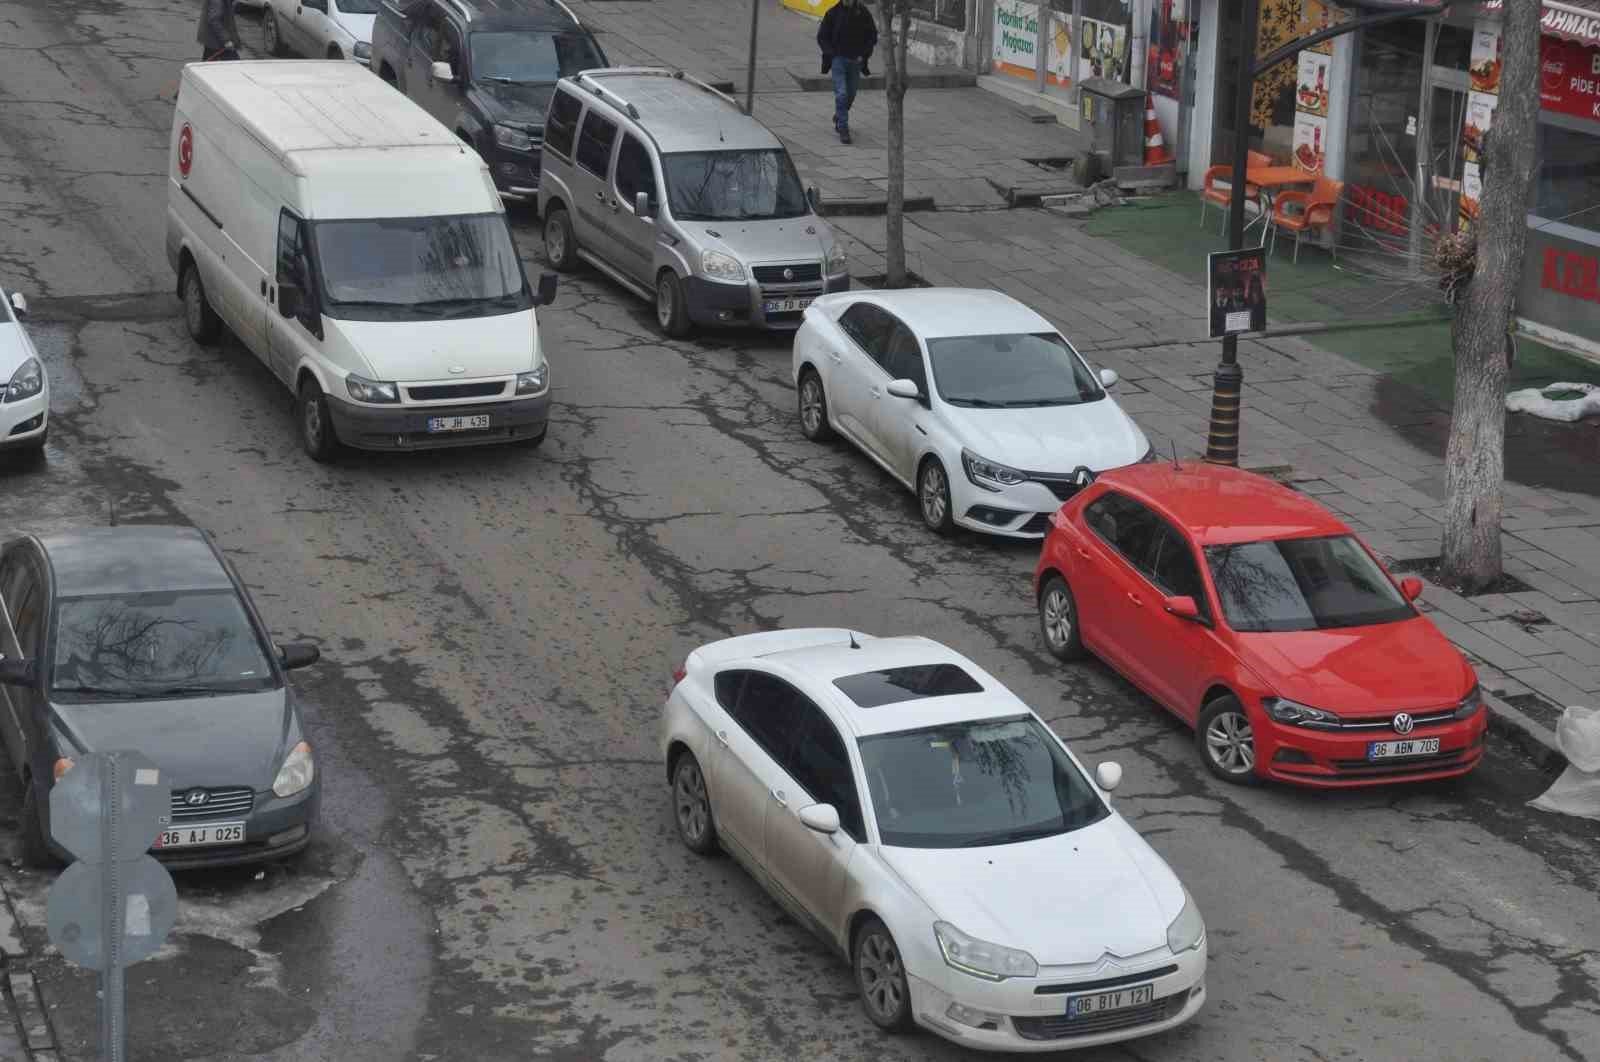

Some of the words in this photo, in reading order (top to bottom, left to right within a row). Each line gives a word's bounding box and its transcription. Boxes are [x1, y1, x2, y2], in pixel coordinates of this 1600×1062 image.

[1570, 75, 1594, 95] PİDE
[1420, 740, 1438, 752] 703
[163, 831, 180, 845] 36
[189, 829, 206, 843] AJ
[215, 826, 241, 841] 025
[1077, 998, 1091, 1013] 06
[1131, 988, 1149, 1004] 121
